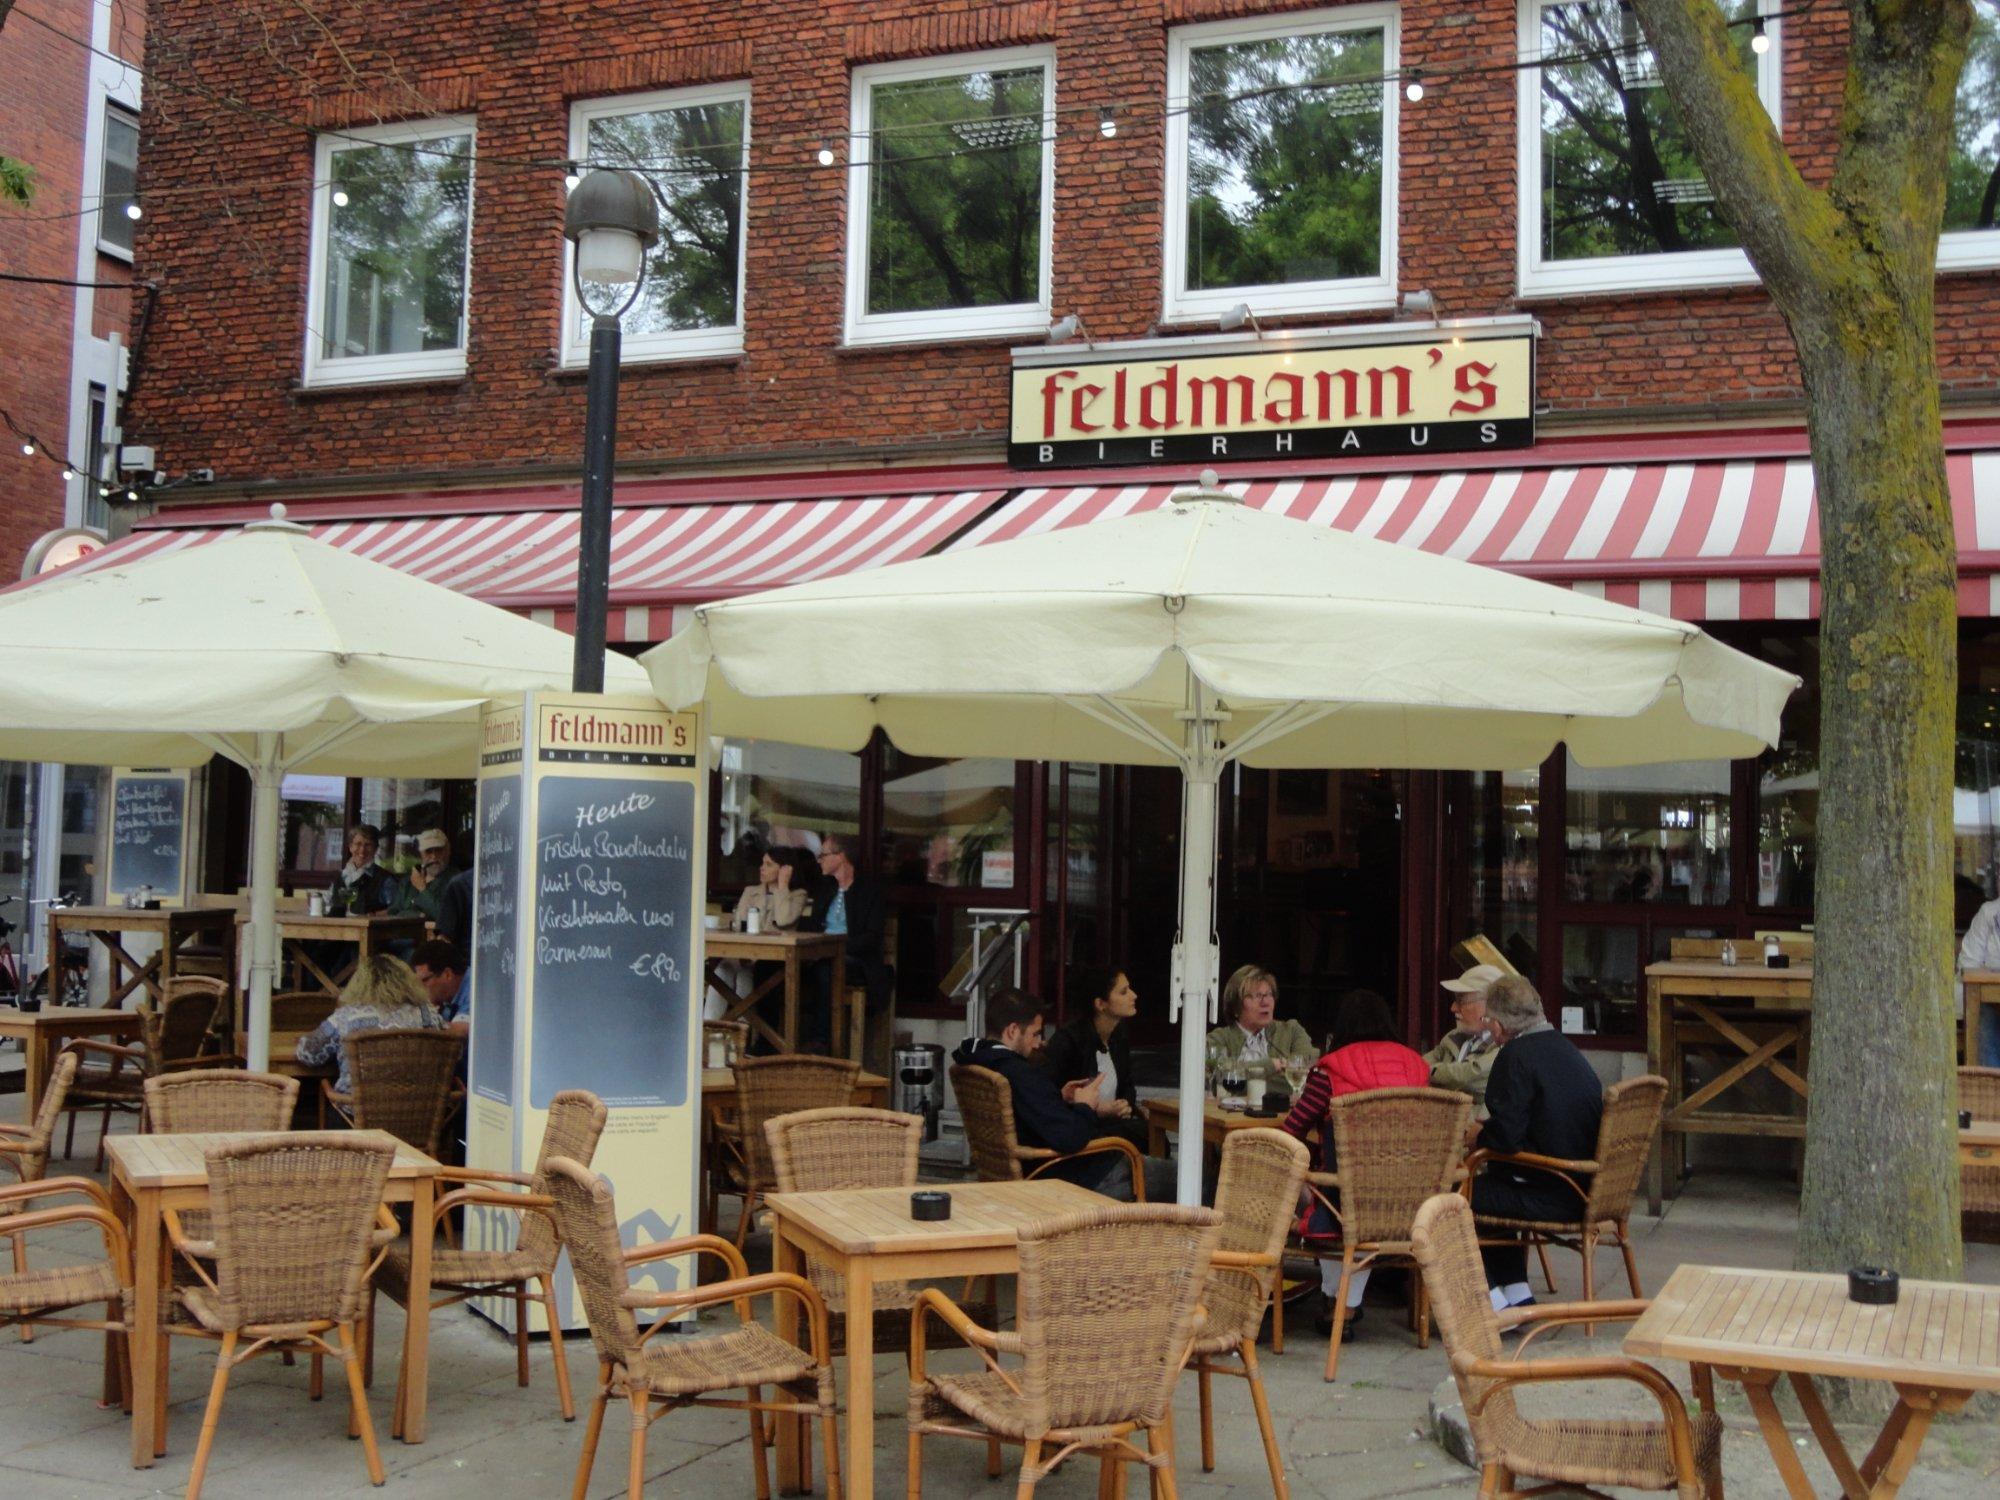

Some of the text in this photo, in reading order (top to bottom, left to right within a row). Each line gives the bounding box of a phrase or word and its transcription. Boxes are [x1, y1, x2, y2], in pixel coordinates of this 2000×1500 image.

[1041, 347, 1498, 438] feldmann's
[1039, 423, 1498, 464] BIERHAUS
[550, 712, 687, 748] feldmann's
[549, 751, 687, 765] BIERHAUS
[576, 792, 656, 828] Heute
[537, 832, 592, 863] Frische
[538, 898, 638, 933] Kirschtomaten
[643, 909, 675, 928] und
[537, 936, 613, 965] Parmesan
